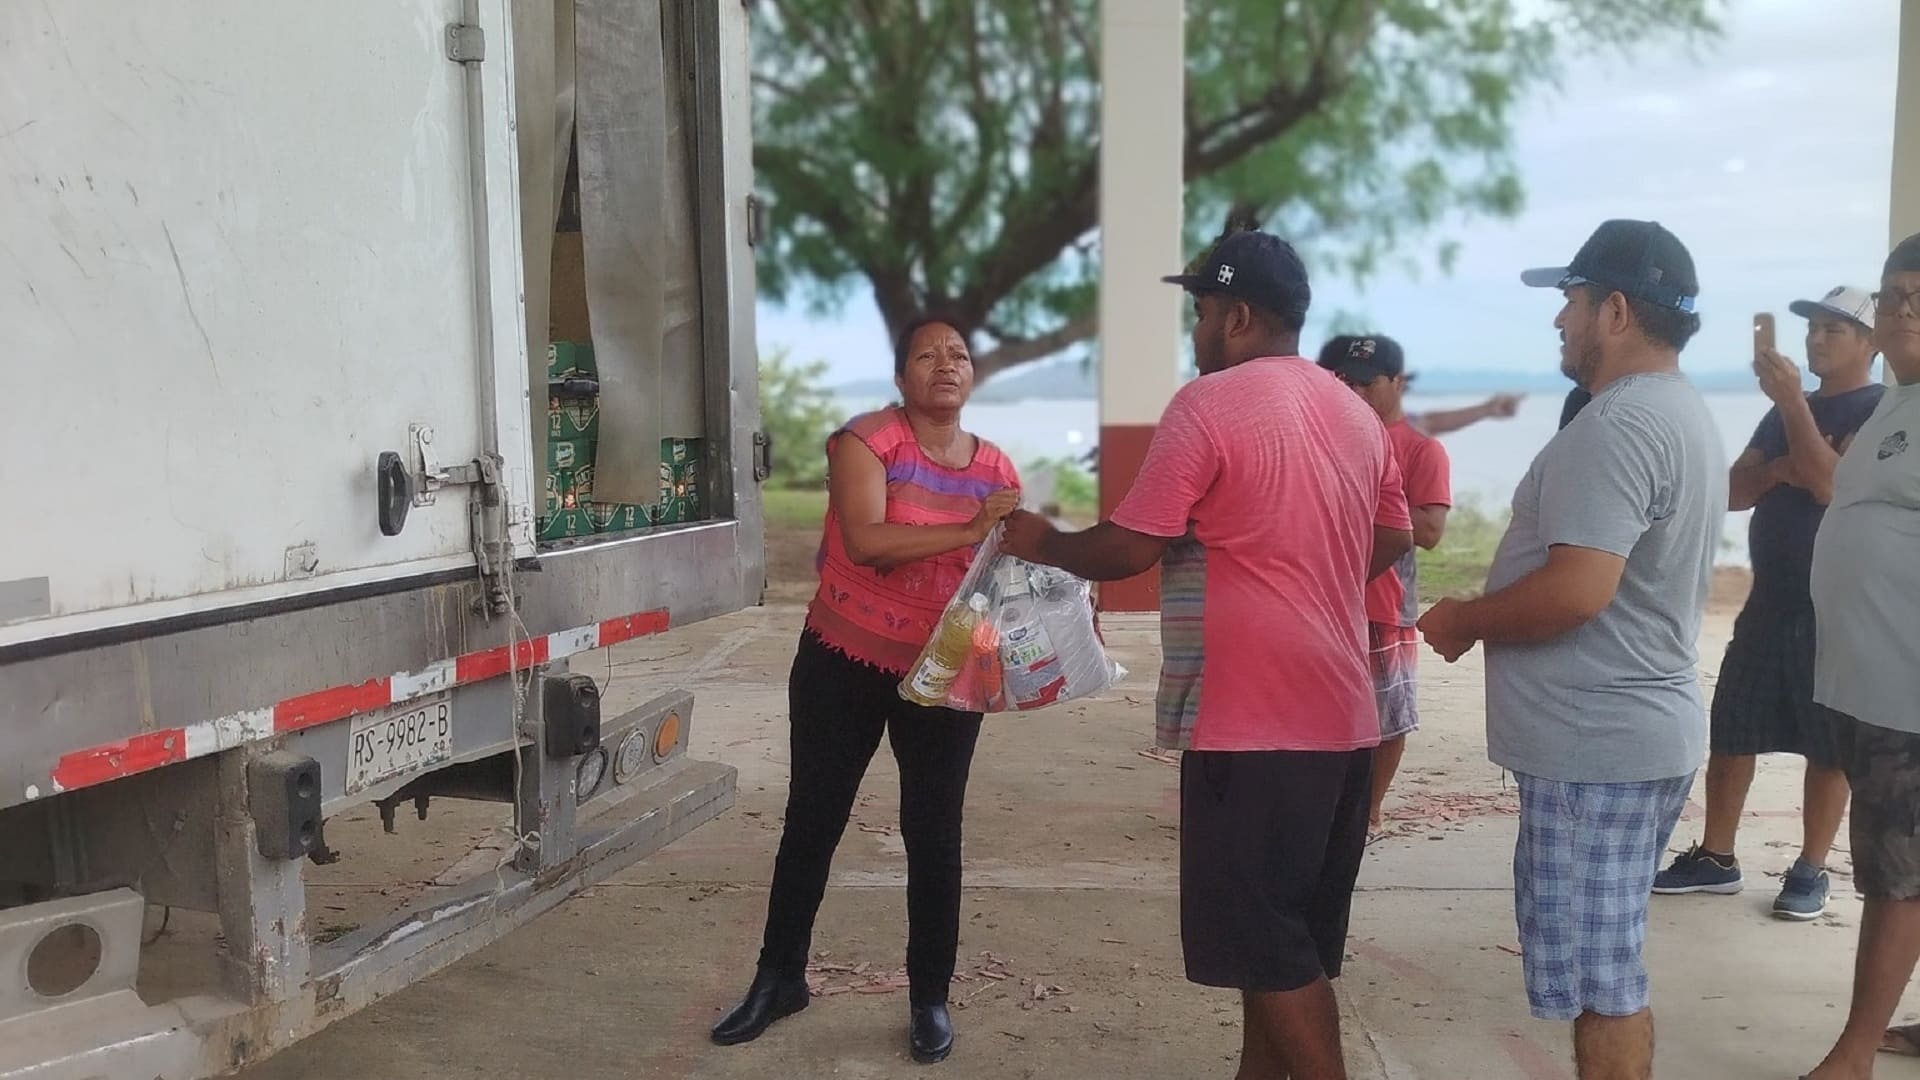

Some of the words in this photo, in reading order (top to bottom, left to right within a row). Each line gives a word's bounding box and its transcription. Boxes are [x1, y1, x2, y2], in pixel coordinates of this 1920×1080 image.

[550, 414, 561, 429] 12
[625, 506, 634, 521] 12
[566, 514, 576, 529] 12
[354, 704, 448, 768] RS-9982-B
